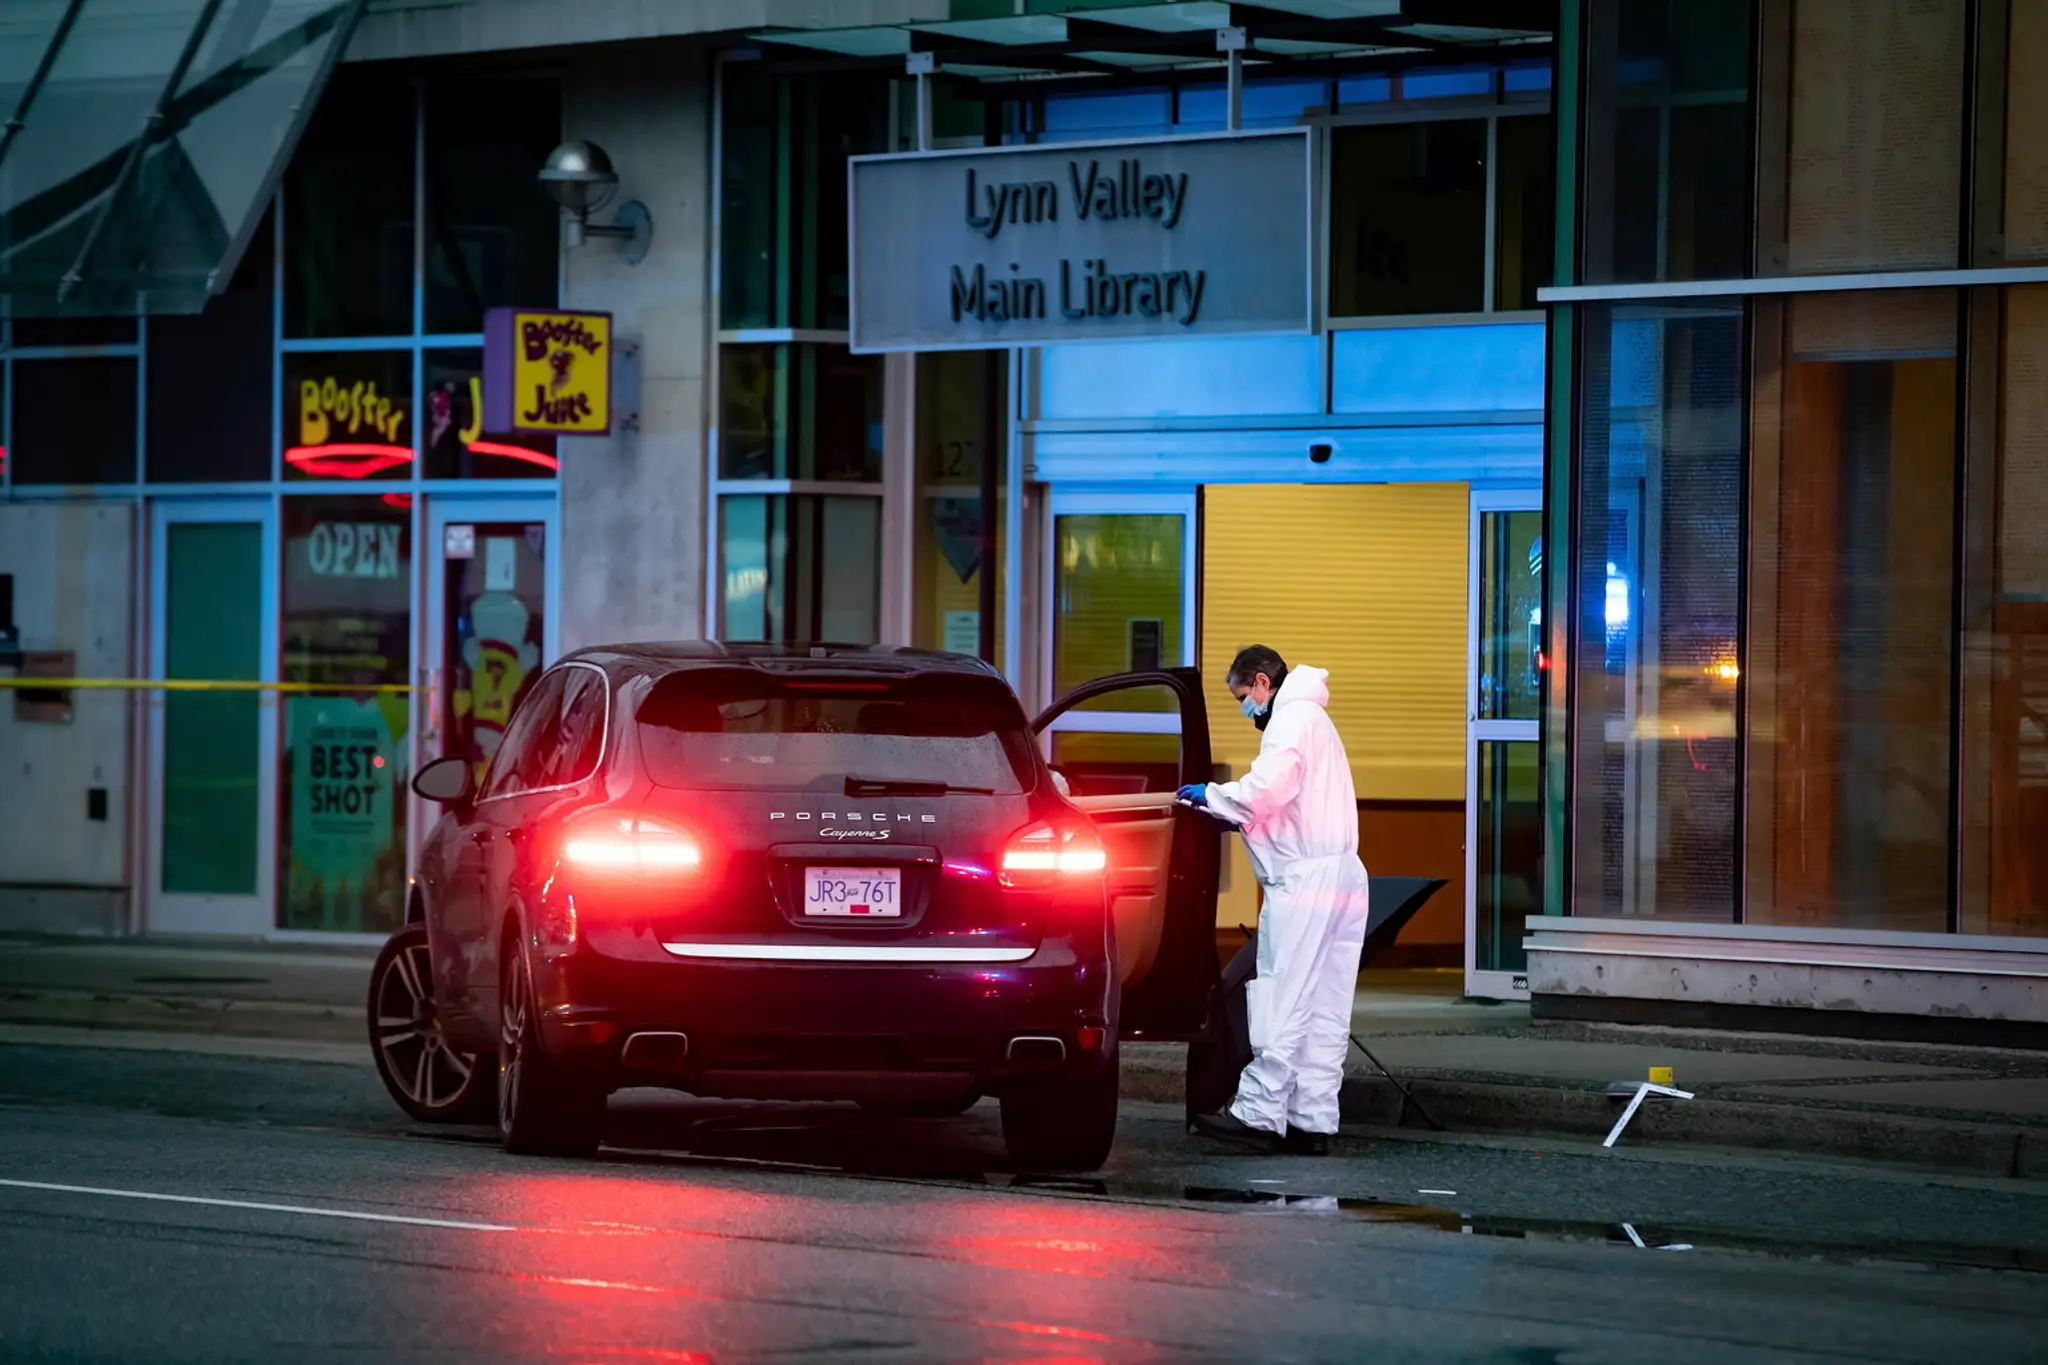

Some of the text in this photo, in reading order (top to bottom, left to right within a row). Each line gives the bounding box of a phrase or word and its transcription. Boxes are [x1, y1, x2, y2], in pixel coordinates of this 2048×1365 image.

[965, 159, 1189, 238] Lynn Valley
[949, 258, 1206, 325] Main Library
[523, 318, 602, 361] Booster
[301, 376, 404, 445] Booster
[308, 522, 402, 579] OPEN
[311, 745, 377, 780] BEST
[311, 784, 377, 816] SHOT
[770, 811, 936, 823] PORSCHE
[819, 827, 891, 841] Cayenne S
